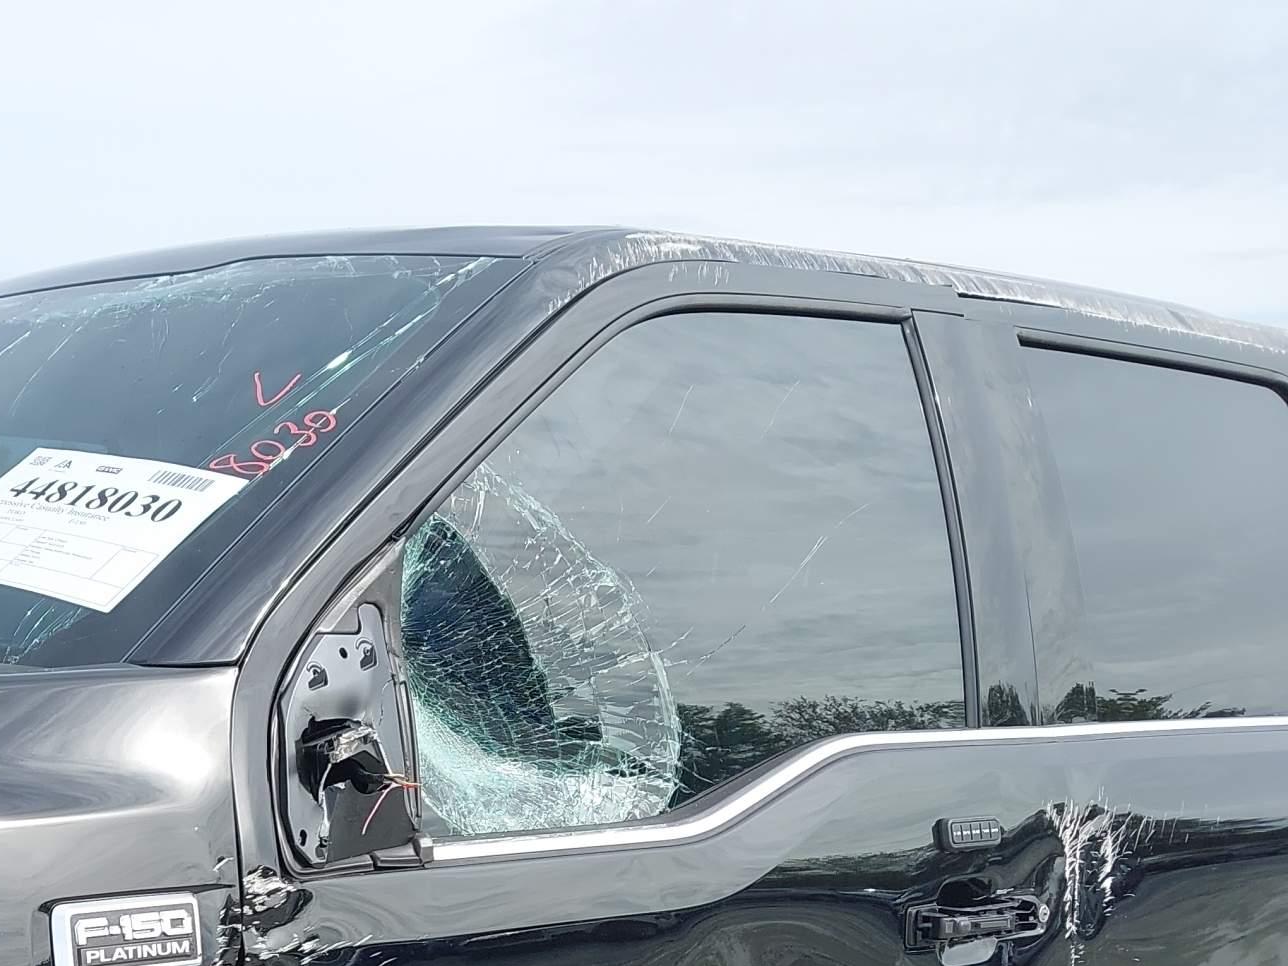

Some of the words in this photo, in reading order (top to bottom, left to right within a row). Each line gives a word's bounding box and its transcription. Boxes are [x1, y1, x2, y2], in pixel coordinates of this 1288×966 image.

[209, 410, 337, 474] 8030
[9, 476, 183, 523] 44818030
[74, 908, 194, 946] F-150
[86, 939, 191, 964] PLATINUM
